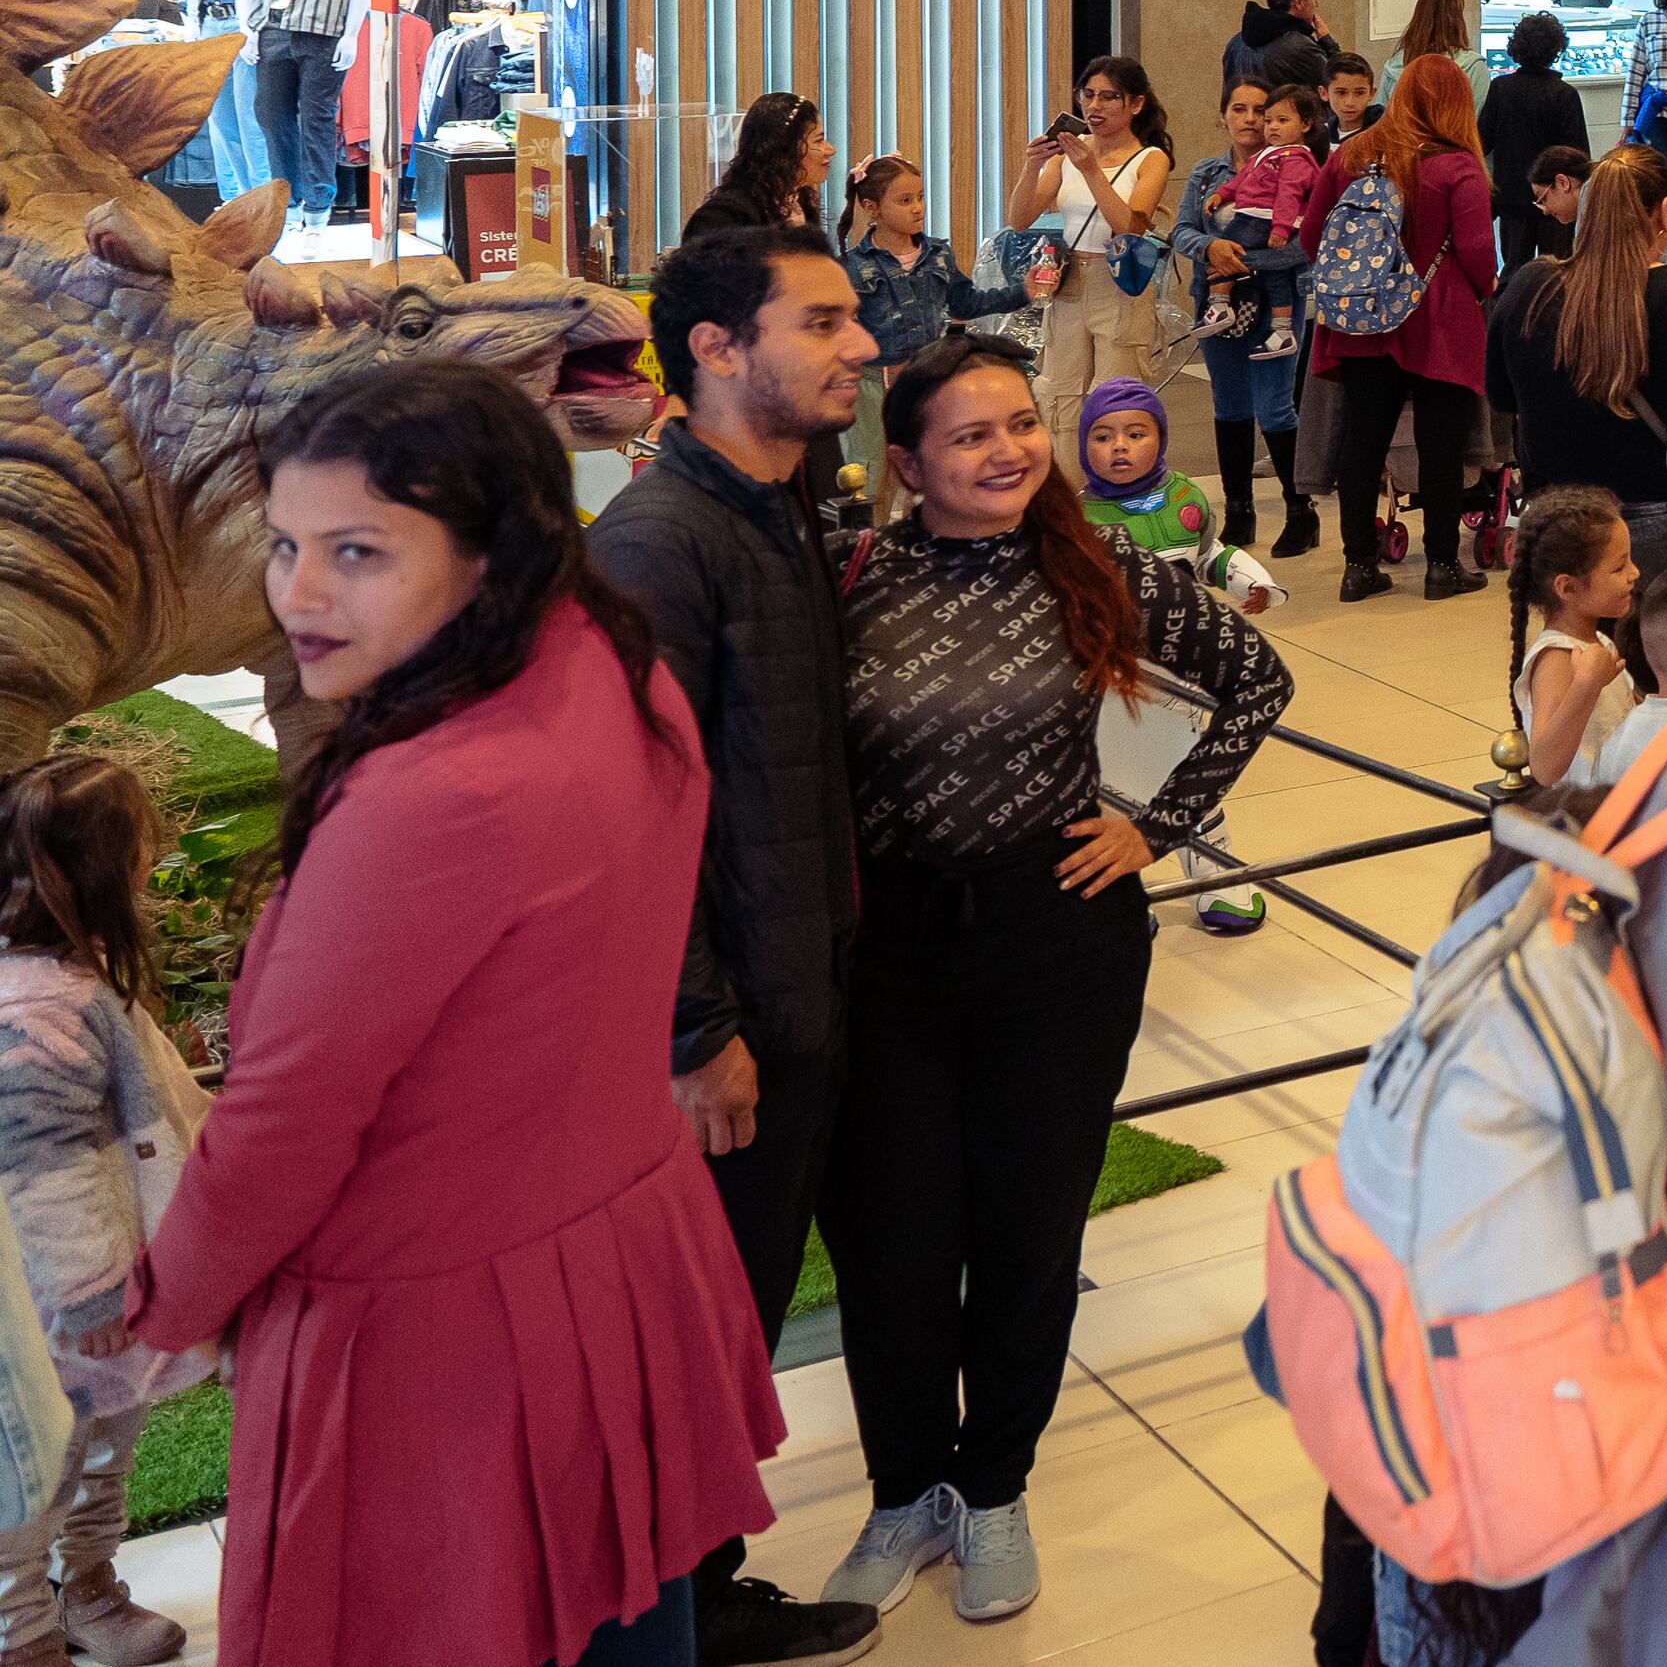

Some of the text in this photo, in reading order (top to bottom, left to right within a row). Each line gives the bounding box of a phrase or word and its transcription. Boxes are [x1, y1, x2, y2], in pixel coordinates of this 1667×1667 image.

[879, 582, 940, 626] PLANET
[933, 572, 999, 623] SPACE
[992, 570, 1041, 613] PLANET
[998, 592, 1059, 641] SPACE
[1160, 607, 1187, 663] SPACE
[893, 635, 963, 683] SPACE
[987, 636, 1054, 686] SPACE
[888, 673, 953, 721] PLANET
[1004, 699, 1068, 743] PLANET
[1223, 695, 1285, 735] SPACE
[941, 704, 1017, 756] SPACE
[1005, 724, 1072, 776] SPACE
[903, 770, 971, 824] SPACE
[987, 771, 1056, 828] SPACE
